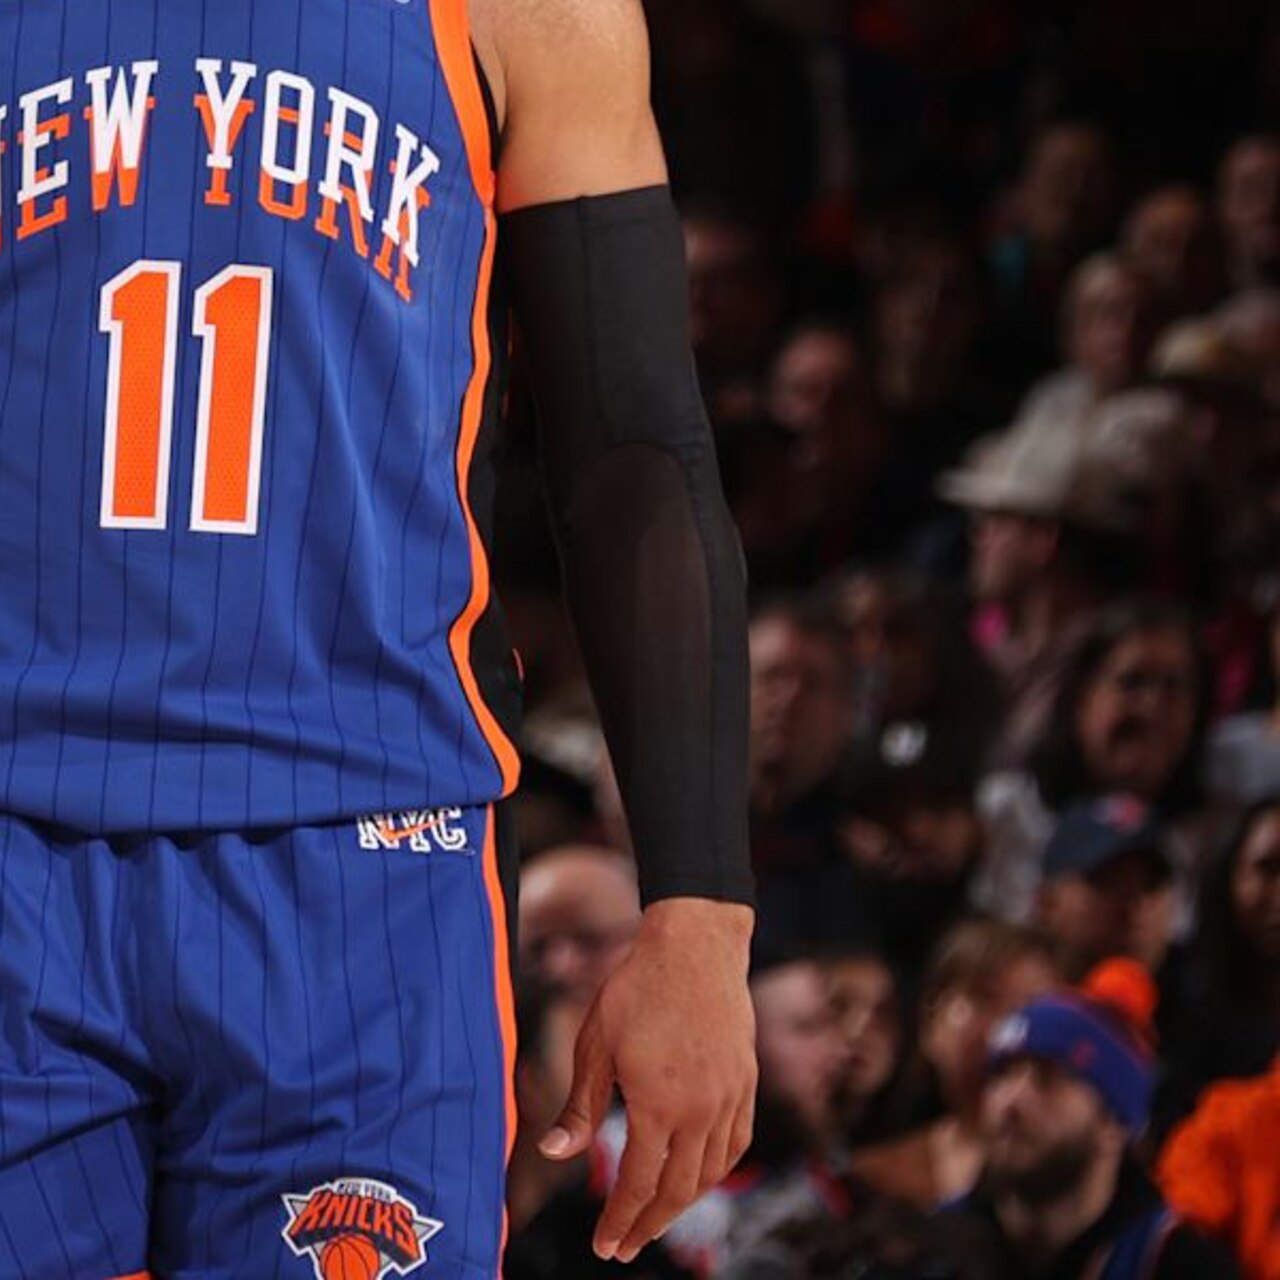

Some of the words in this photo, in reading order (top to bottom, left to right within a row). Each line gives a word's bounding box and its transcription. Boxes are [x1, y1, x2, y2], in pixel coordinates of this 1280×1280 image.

[194, 58, 440, 302] YORK
[99, 259, 274, 534] 11
[289, 1190, 421, 1261] KNICKS
